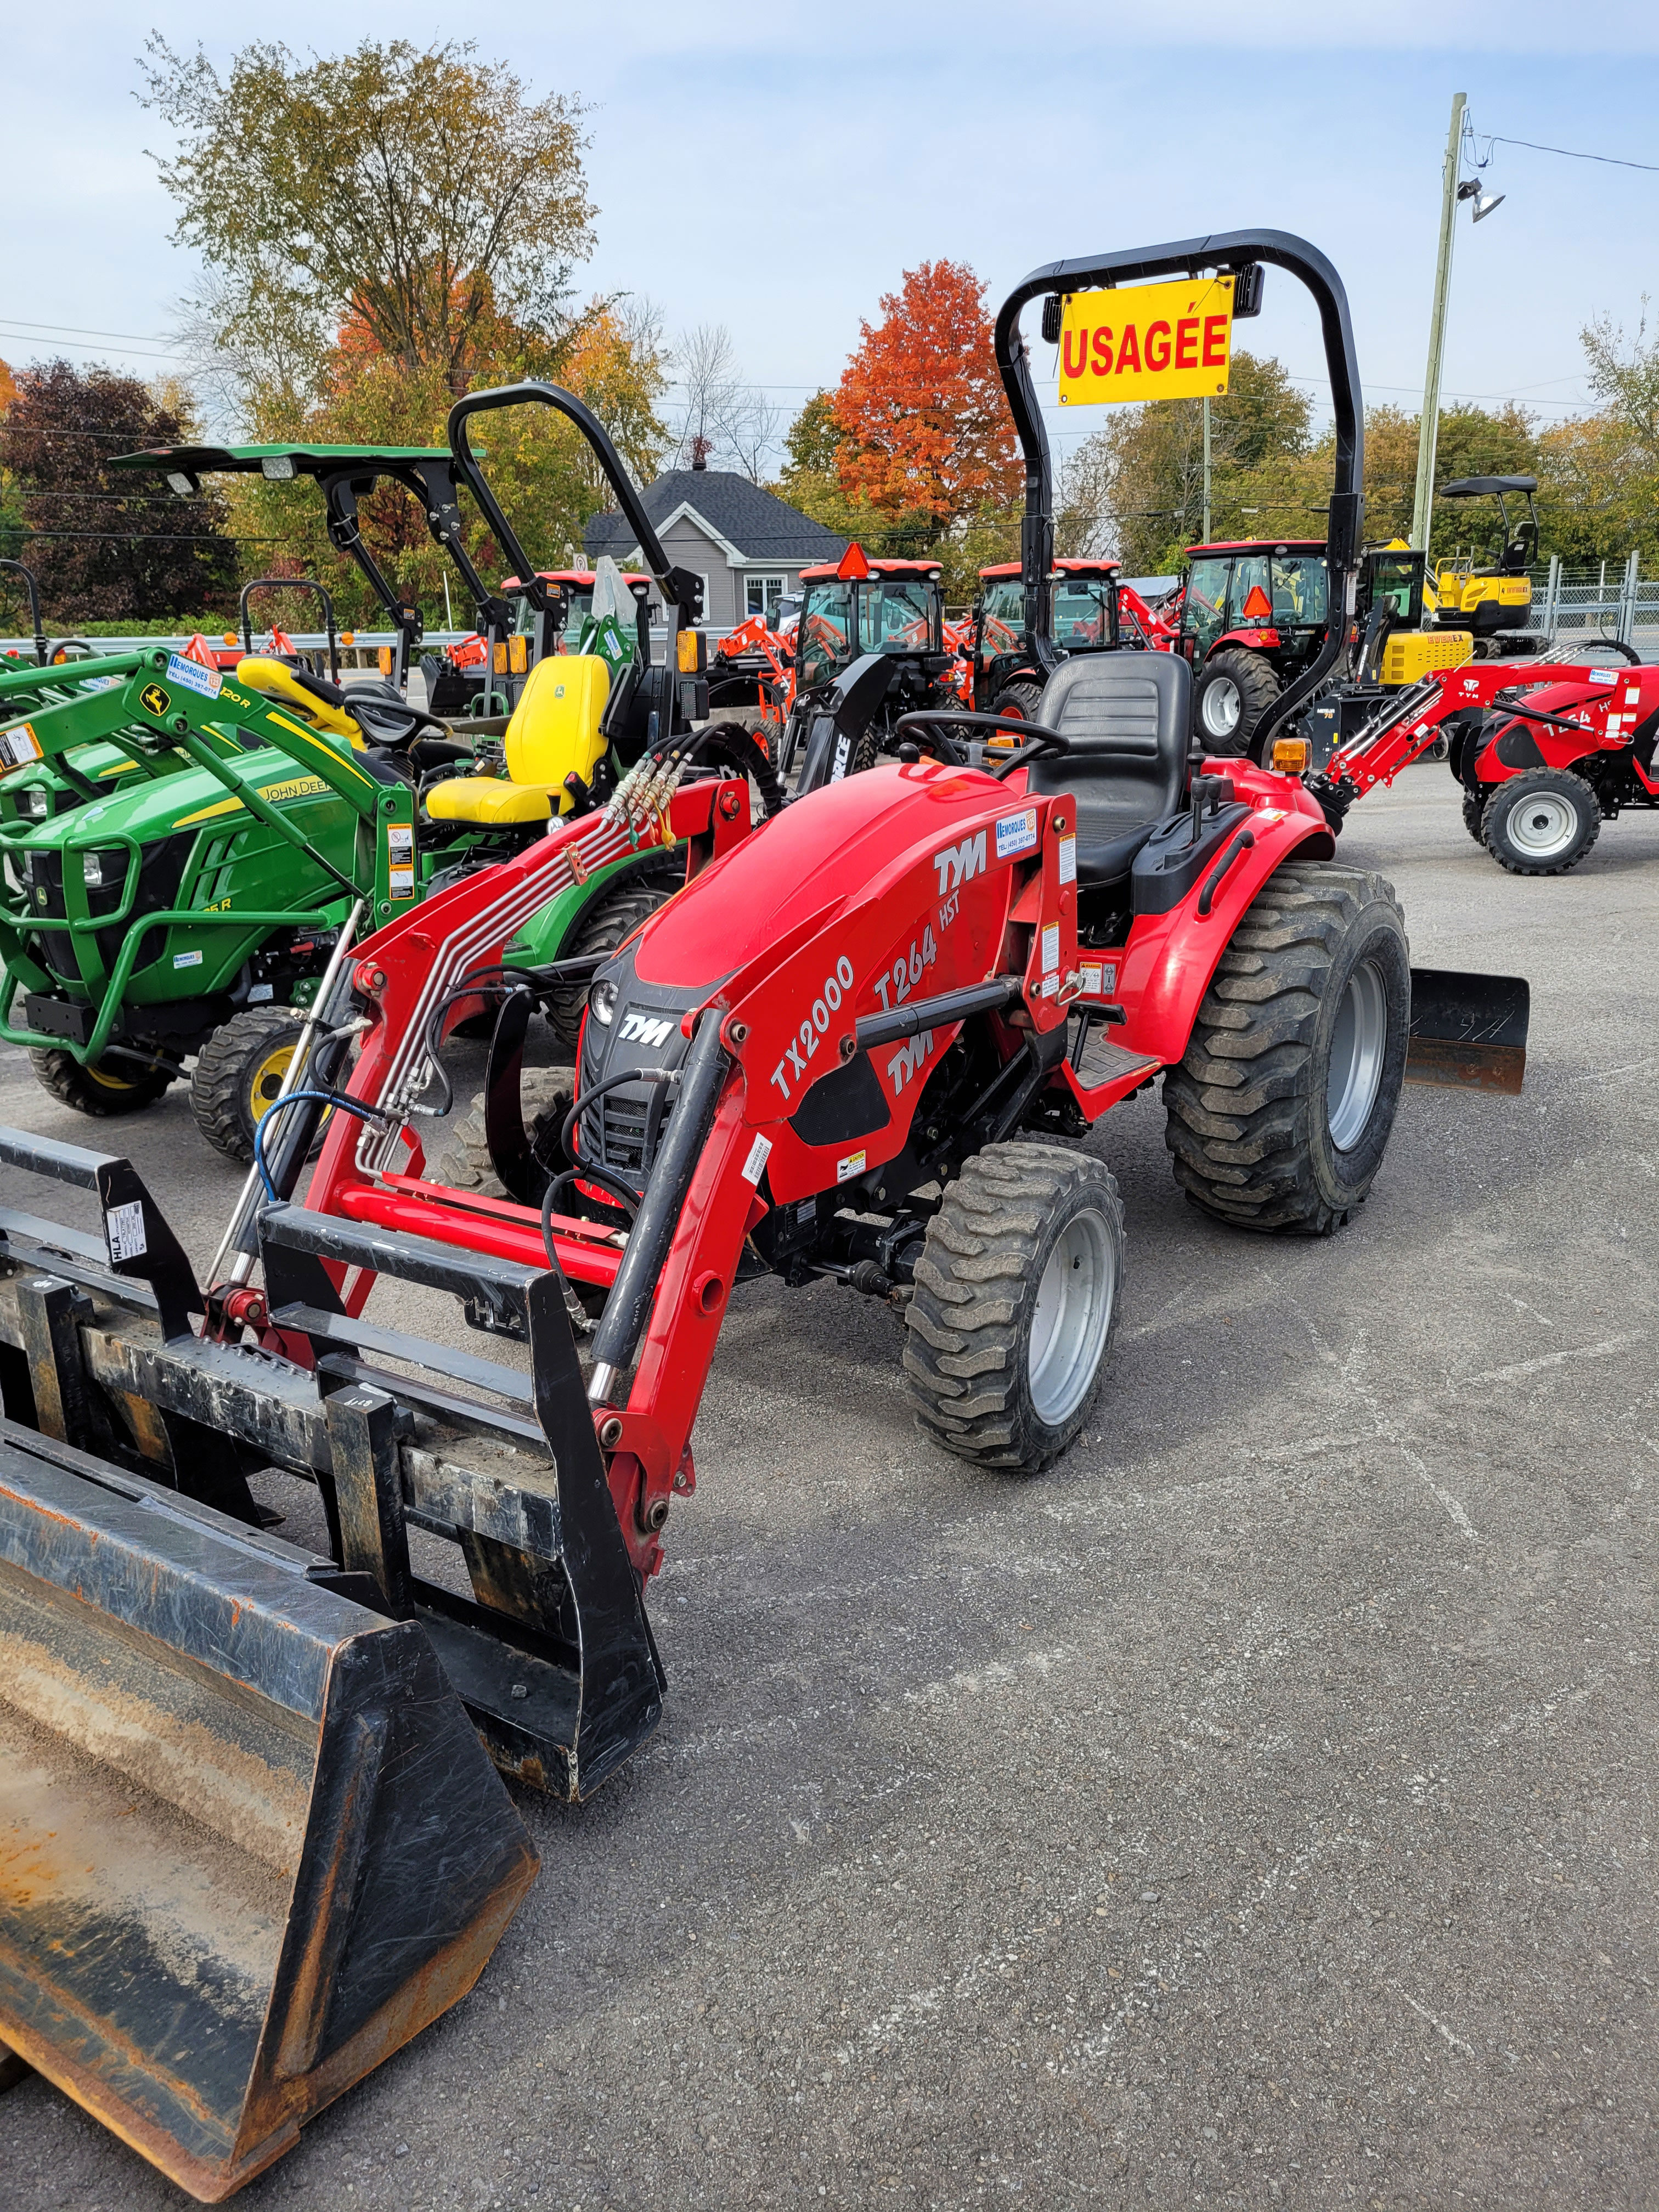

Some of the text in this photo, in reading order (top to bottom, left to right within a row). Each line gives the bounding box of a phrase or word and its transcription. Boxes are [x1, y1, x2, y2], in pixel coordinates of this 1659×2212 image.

[1063, 301, 1228, 379] USAGÉE
[1427, 634, 1464, 644] EVEREX
[170, 656, 208, 682] REMORQUES
[220, 686, 251, 709] 120 R
[266, 785, 298, 801] JOHN
[997, 819, 1026, 839] REMORQUES
[1007, 840, 1018, 849] (450)
[1018, 833, 1035, 844] 397-0774
[934, 829, 987, 897] TYM
[221, 898, 231, 911] R
[939, 888, 960, 932] HST
[618, 1014, 675, 1048] TYM
[770, 955, 854, 1101] TX2000
[887, 1029, 934, 1097] TYM
[112, 1236, 122, 1260] HLA
